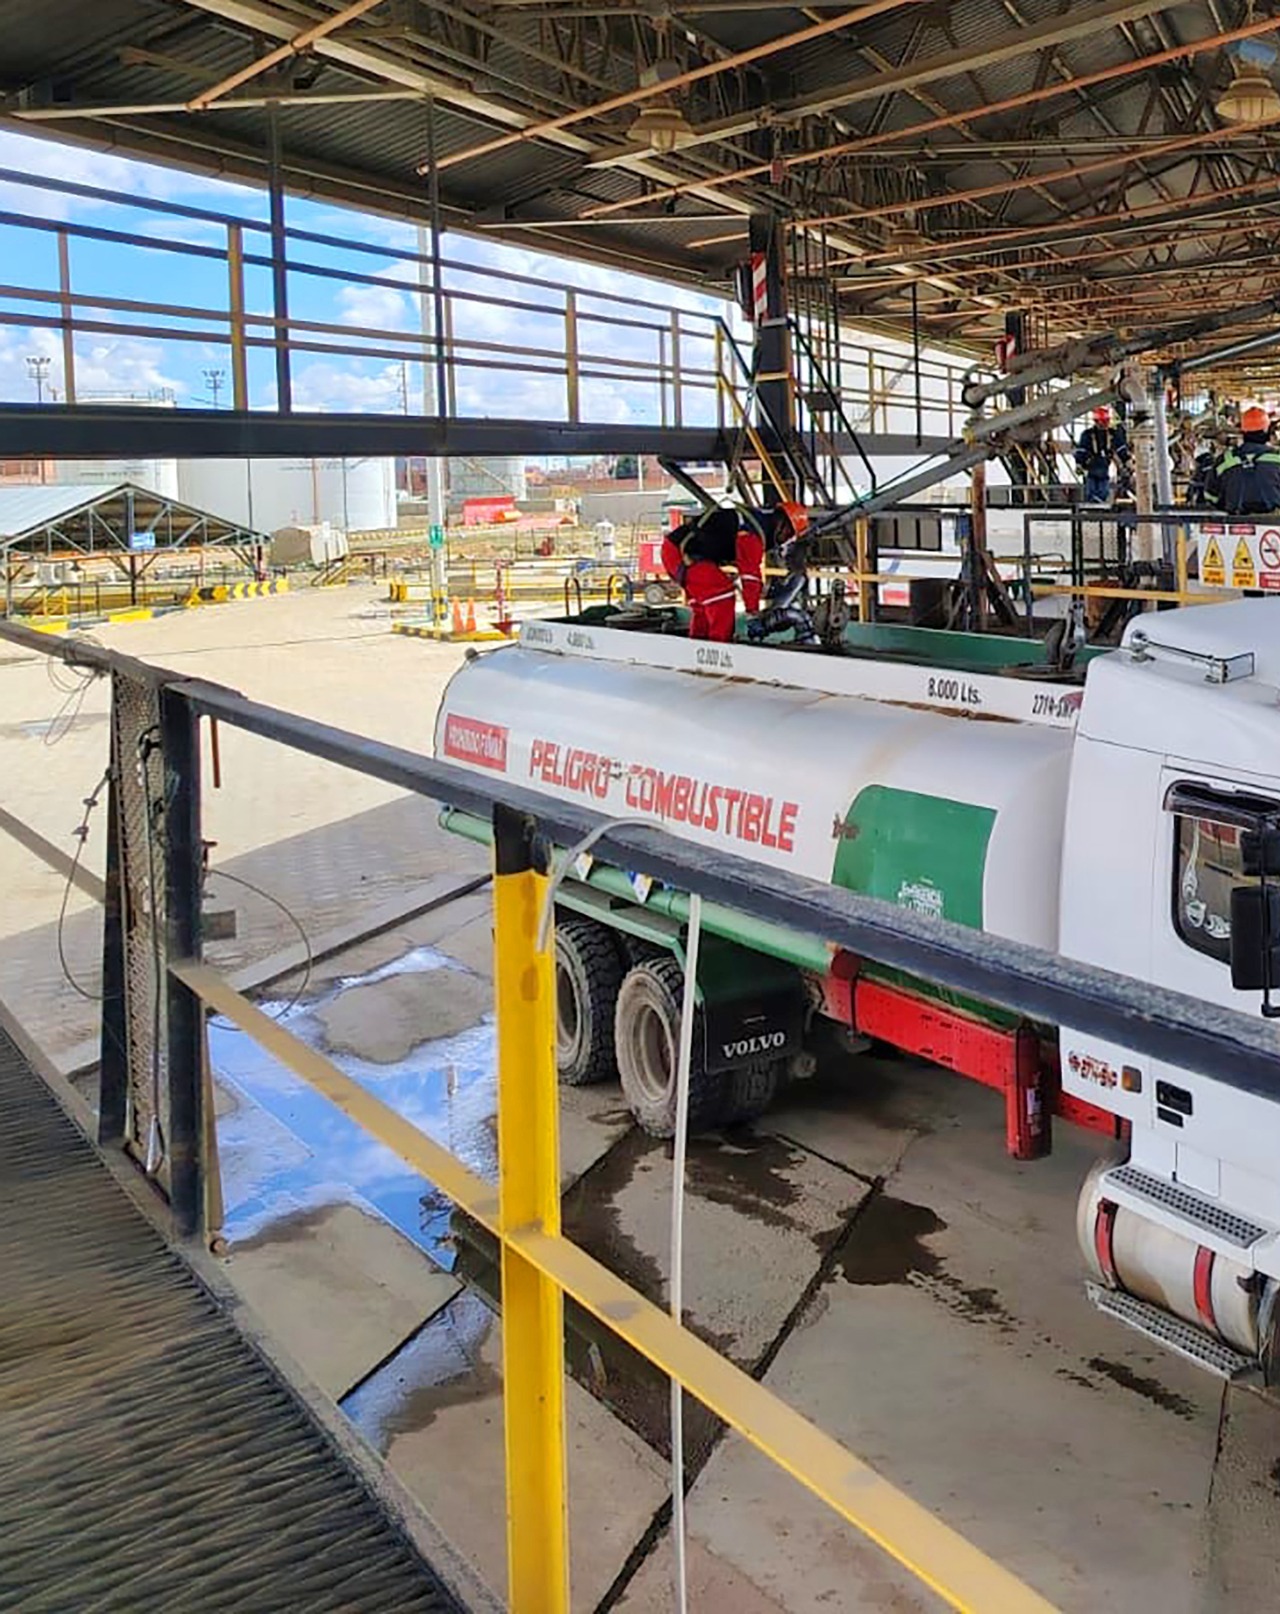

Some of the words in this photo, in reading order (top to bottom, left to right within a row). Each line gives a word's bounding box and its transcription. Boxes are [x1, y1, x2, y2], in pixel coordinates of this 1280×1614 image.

[928, 677, 959, 701] 8.000
[960, 682, 982, 705] Lts.
[530, 738, 611, 800] PELIGRO
[625, 763, 800, 852] COMBUSTIBLE
[722, 1031, 785, 1058] VOLVO
